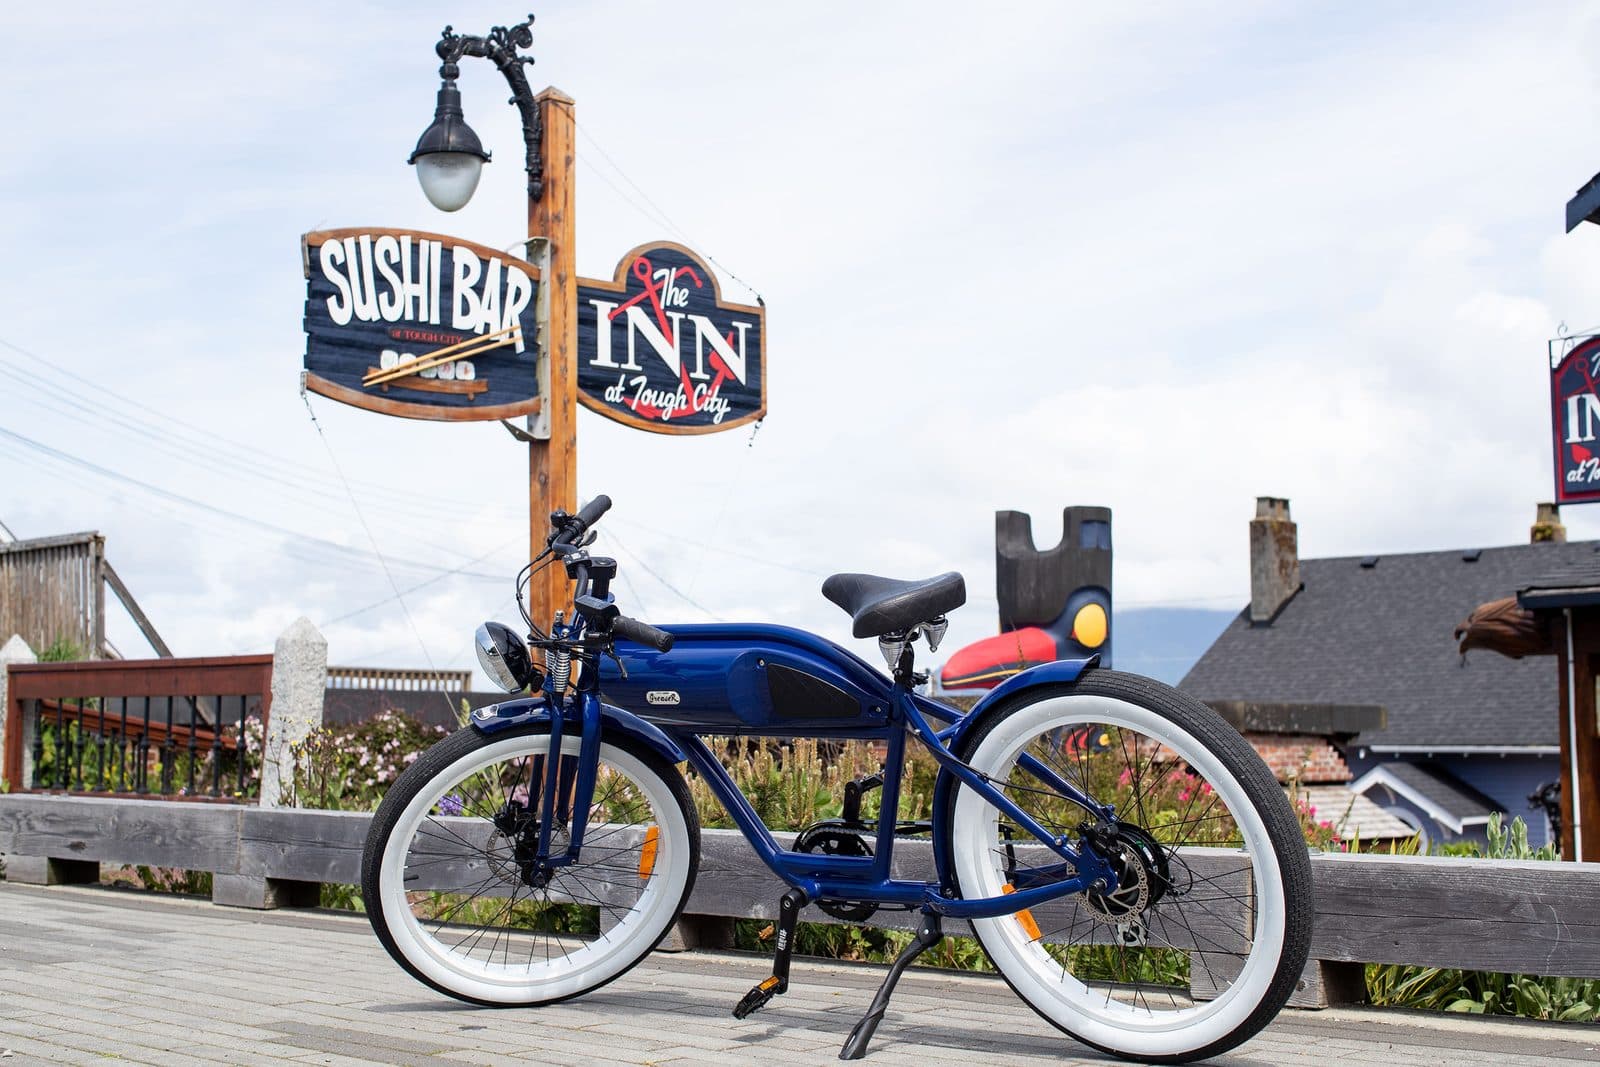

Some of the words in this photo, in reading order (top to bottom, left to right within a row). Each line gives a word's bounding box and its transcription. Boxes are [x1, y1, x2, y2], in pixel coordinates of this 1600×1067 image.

[320, 235, 442, 325] SUSHI
[452, 245, 532, 354] BAR
[653, 267, 689, 310] The
[404, 329, 437, 342] TOUGH
[440, 335, 461, 344] CITY
[589, 299, 752, 386] INN
[605, 374, 626, 403] at
[630, 376, 687, 421] Tough
[693, 383, 731, 424] City
[1566, 393, 1600, 443] IN
[1567, 460, 1585, 482] at
